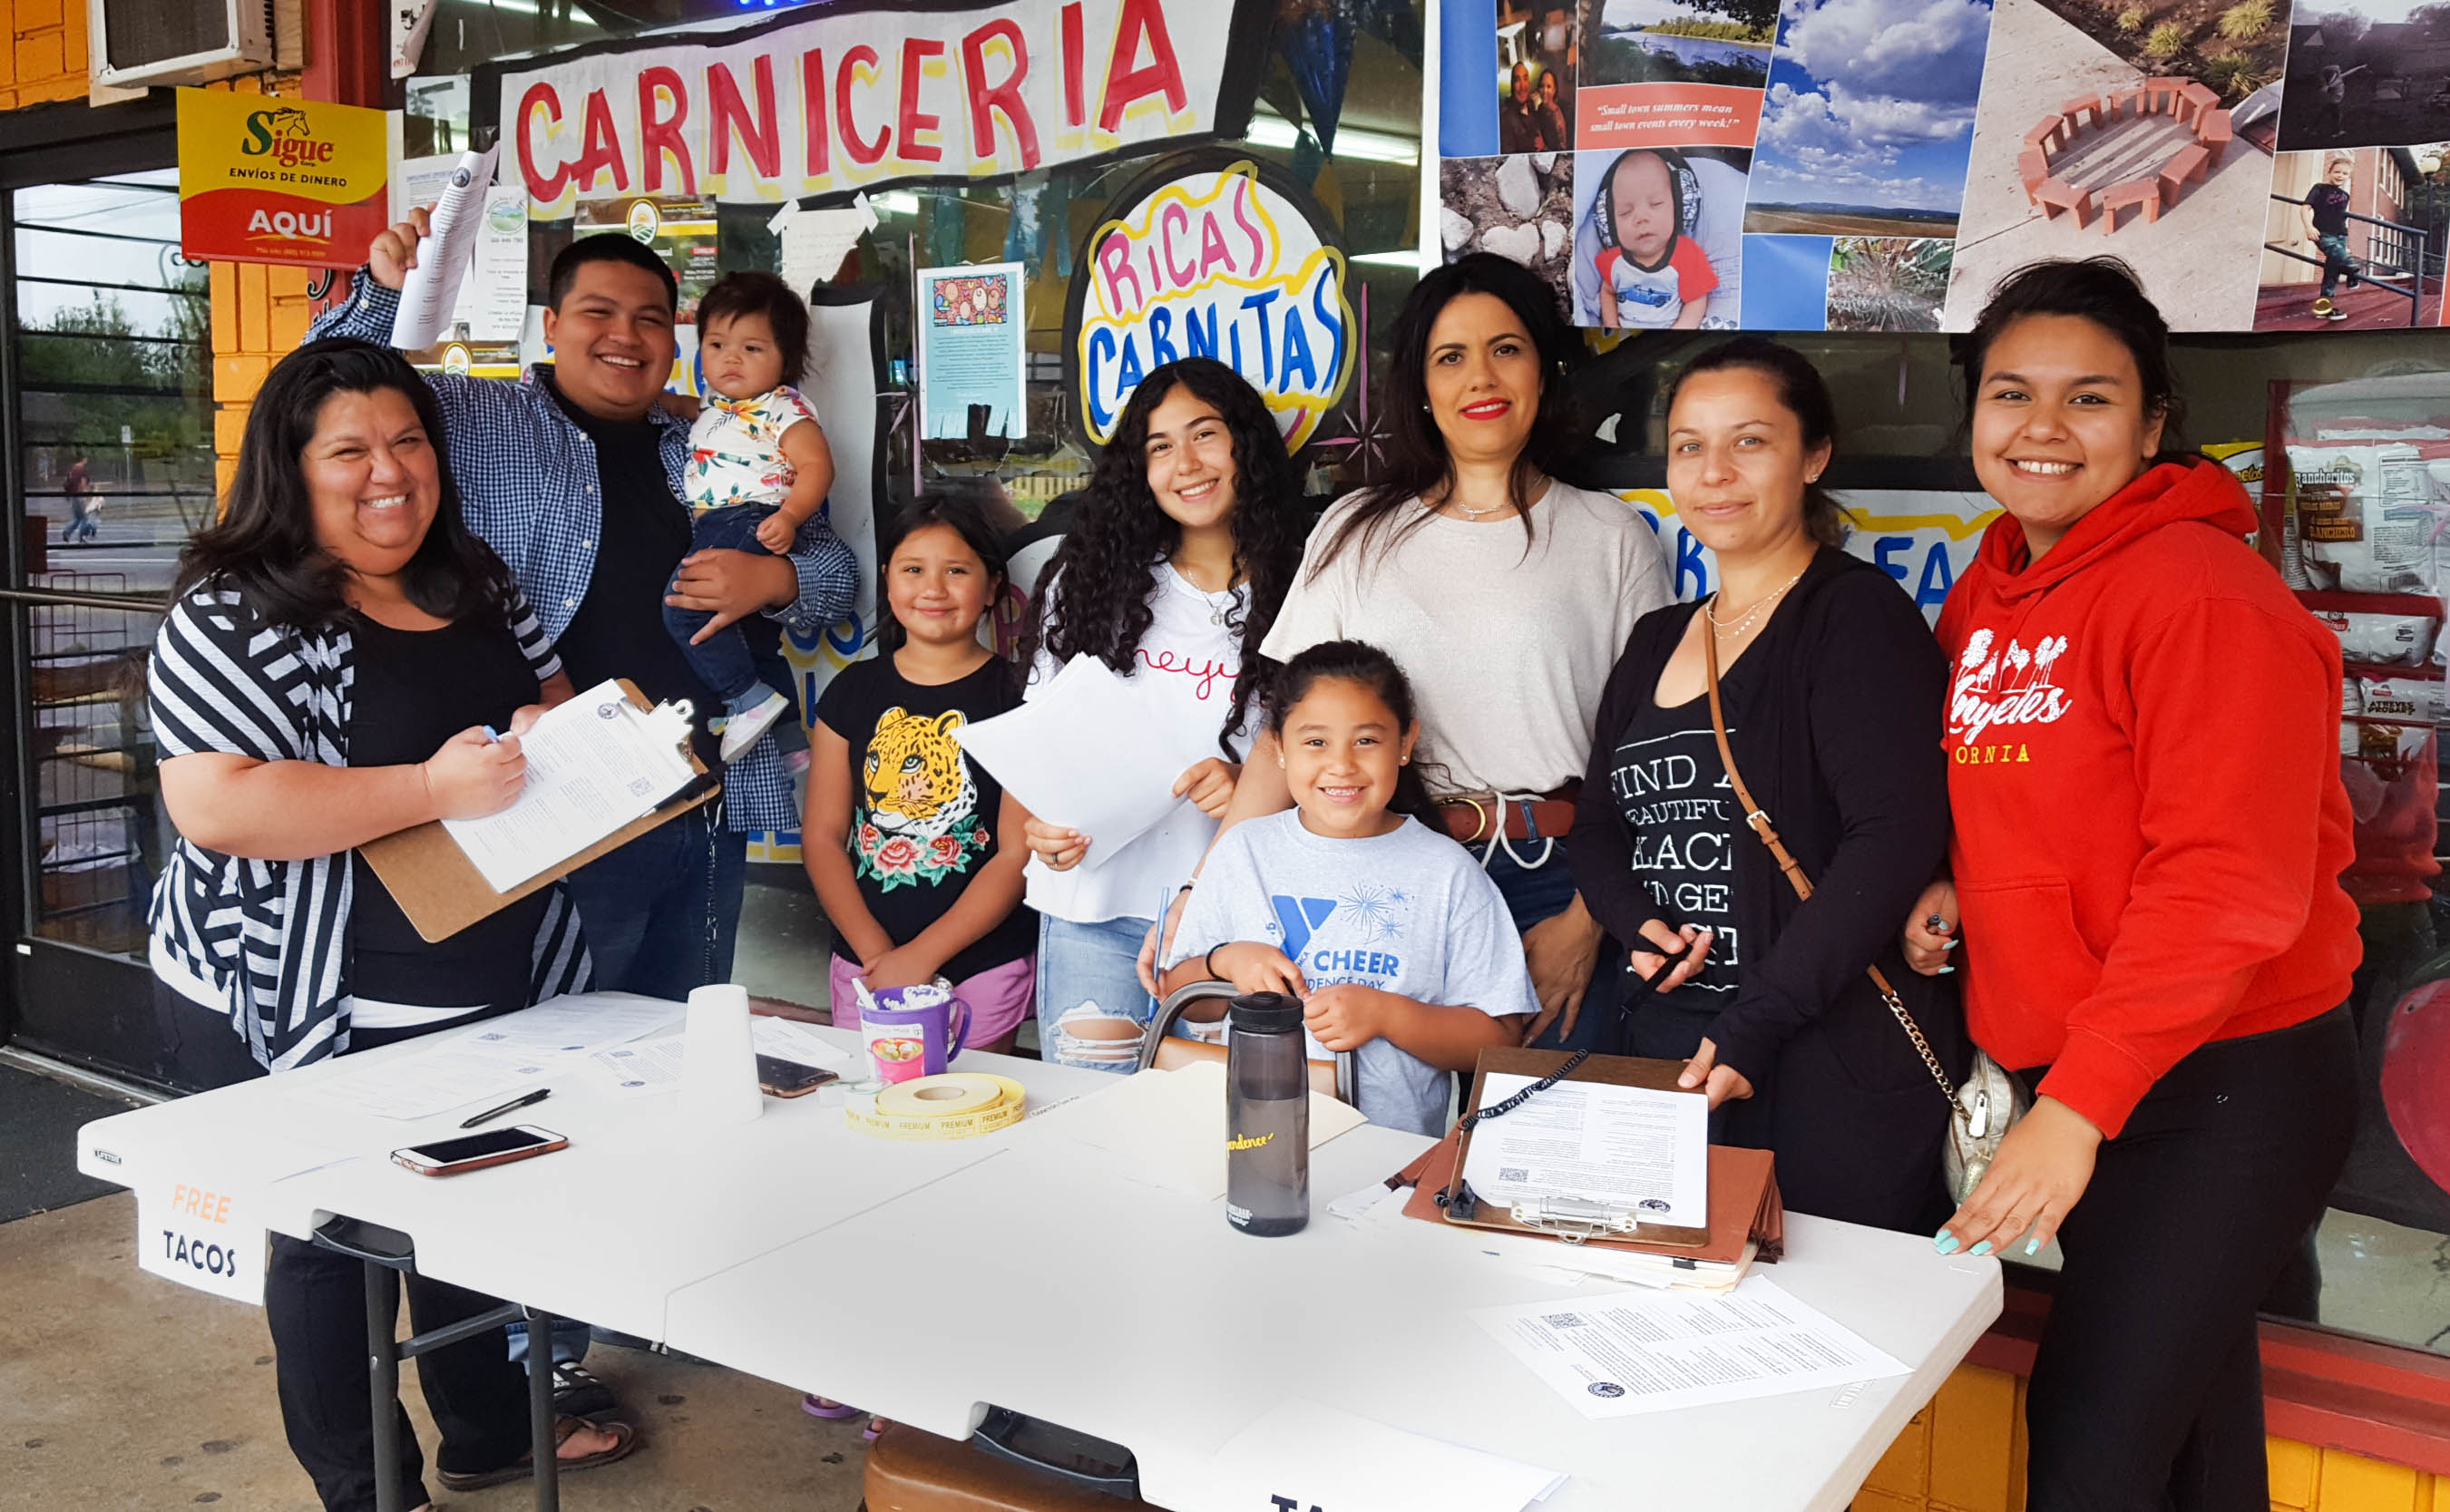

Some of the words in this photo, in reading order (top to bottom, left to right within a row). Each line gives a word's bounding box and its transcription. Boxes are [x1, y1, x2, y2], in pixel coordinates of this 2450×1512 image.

[516, 0, 1186, 203] CARNICERIA
[1628, 104, 1649, 114] town
[1652, 102, 1698, 112] summers
[1701, 104, 1733, 114] mean
[242, 111, 334, 167] Sigue
[1589, 120, 1614, 132] small
[1615, 121, 1635, 131] town
[1637, 118, 1665, 129] events
[1668, 118, 1697, 129] every
[229, 167, 276, 180] ENVÍOS
[280, 172, 296, 182] DE
[300, 174, 347, 188] DINERO
[248, 209, 333, 239] AQUÍ
[1099, 178, 1264, 316] RICAS
[1088, 266, 1342, 426] CARNITAS
[1313, 949, 1401, 978] CHEER
[941, 1117, 973, 1129] PREMIUM
[172, 1184, 231, 1224] FREE
[163, 1230, 236, 1278] TACOS
